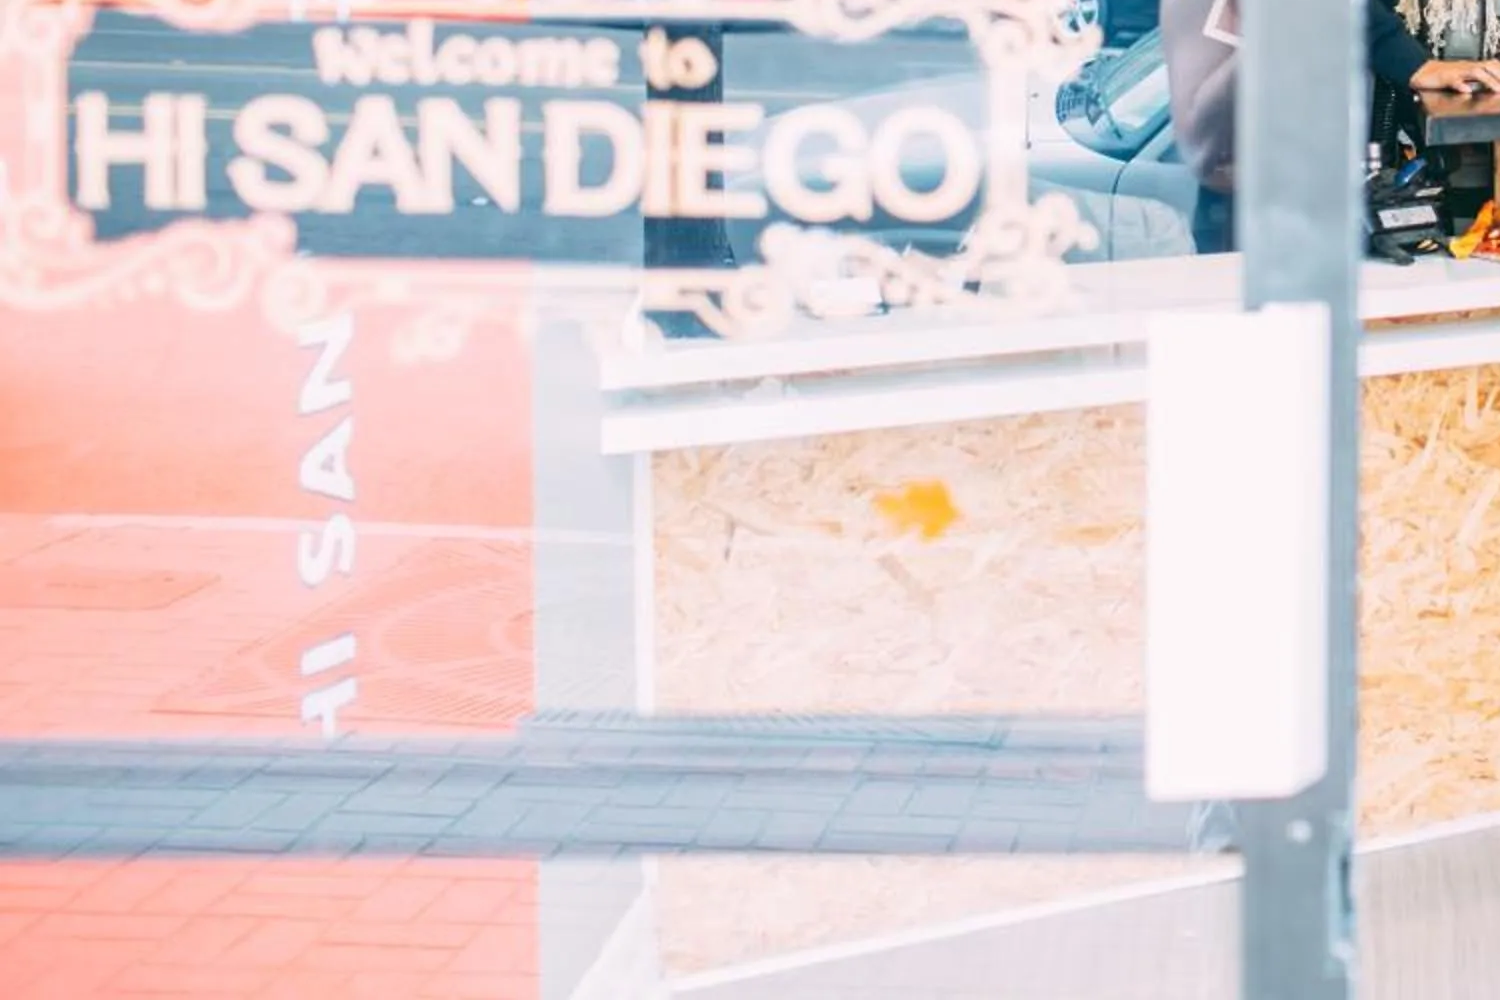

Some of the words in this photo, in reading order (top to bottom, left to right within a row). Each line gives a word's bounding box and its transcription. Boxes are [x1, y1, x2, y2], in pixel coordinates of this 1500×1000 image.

[639, 27, 718, 90] to
[75, 91, 208, 212] HI
[226, 93, 521, 215] SAN
[543, 99, 986, 224] DIEGO
[298, 312, 356, 588] SAN
